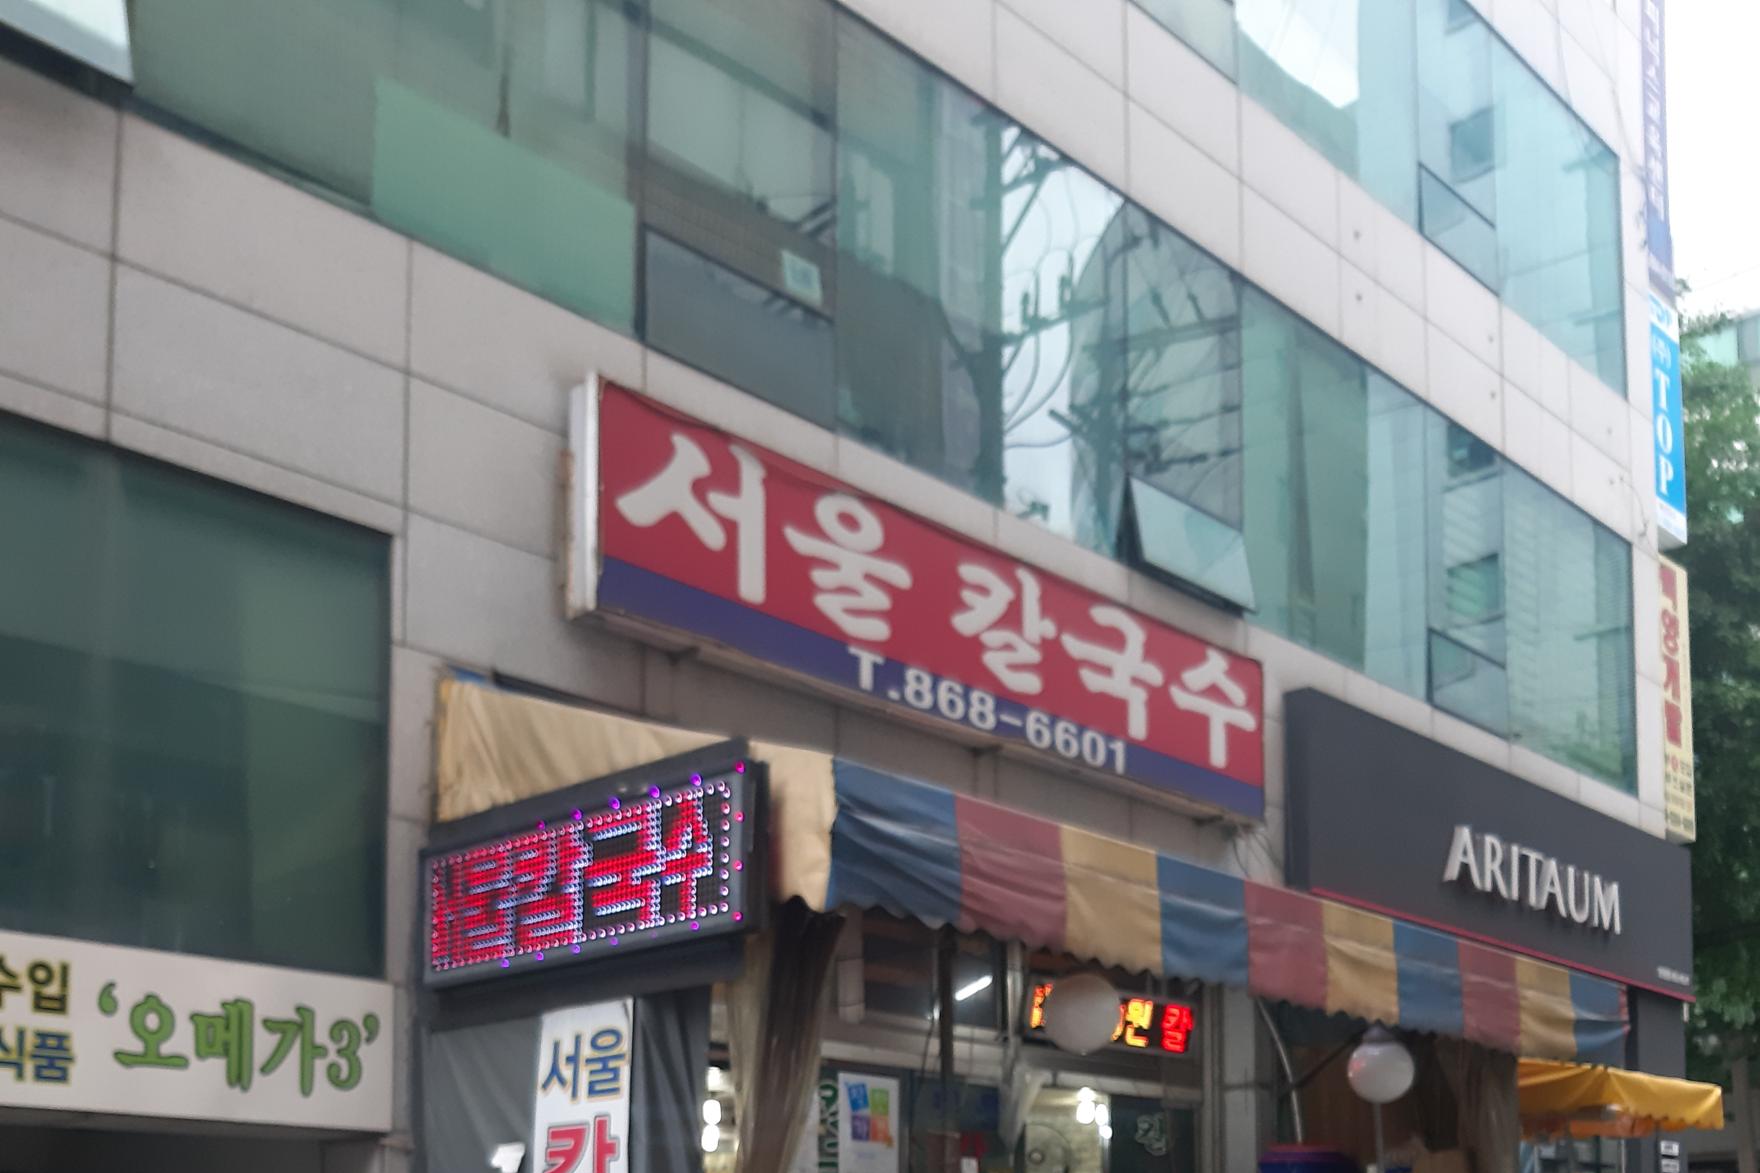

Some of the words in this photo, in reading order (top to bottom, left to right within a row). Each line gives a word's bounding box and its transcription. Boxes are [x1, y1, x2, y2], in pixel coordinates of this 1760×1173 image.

[1655, 367, 1674, 497] TOP
[615, 433, 912, 642] 서울
[950, 561, 1256, 769] 칼국수
[847, 644, 1127, 776] T.868-6601
[1443, 825, 1621, 936] ARITAUM
[541, 1026, 628, 1102] 서울
